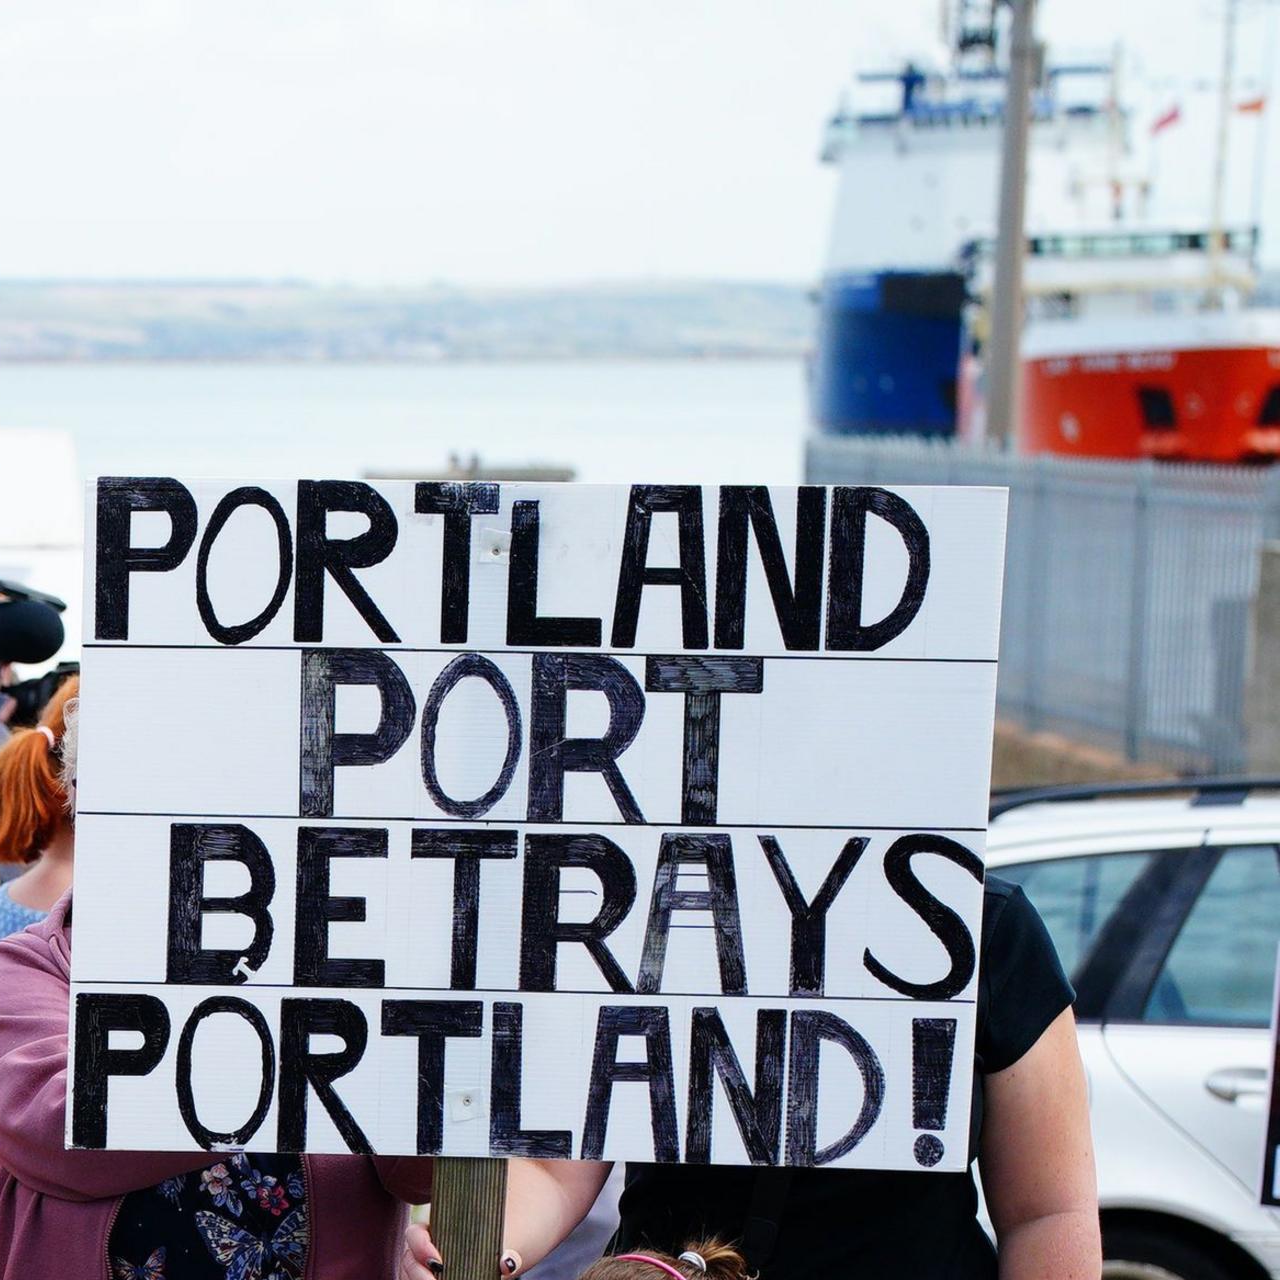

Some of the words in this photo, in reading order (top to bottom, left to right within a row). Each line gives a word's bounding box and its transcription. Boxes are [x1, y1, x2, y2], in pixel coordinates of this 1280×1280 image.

[94, 476, 931, 652] PORTLAND
[298, 648, 764, 825] PORT
[166, 821, 985, 1000] BETRAYS
[71, 992, 957, 1168] PORTLAND!
